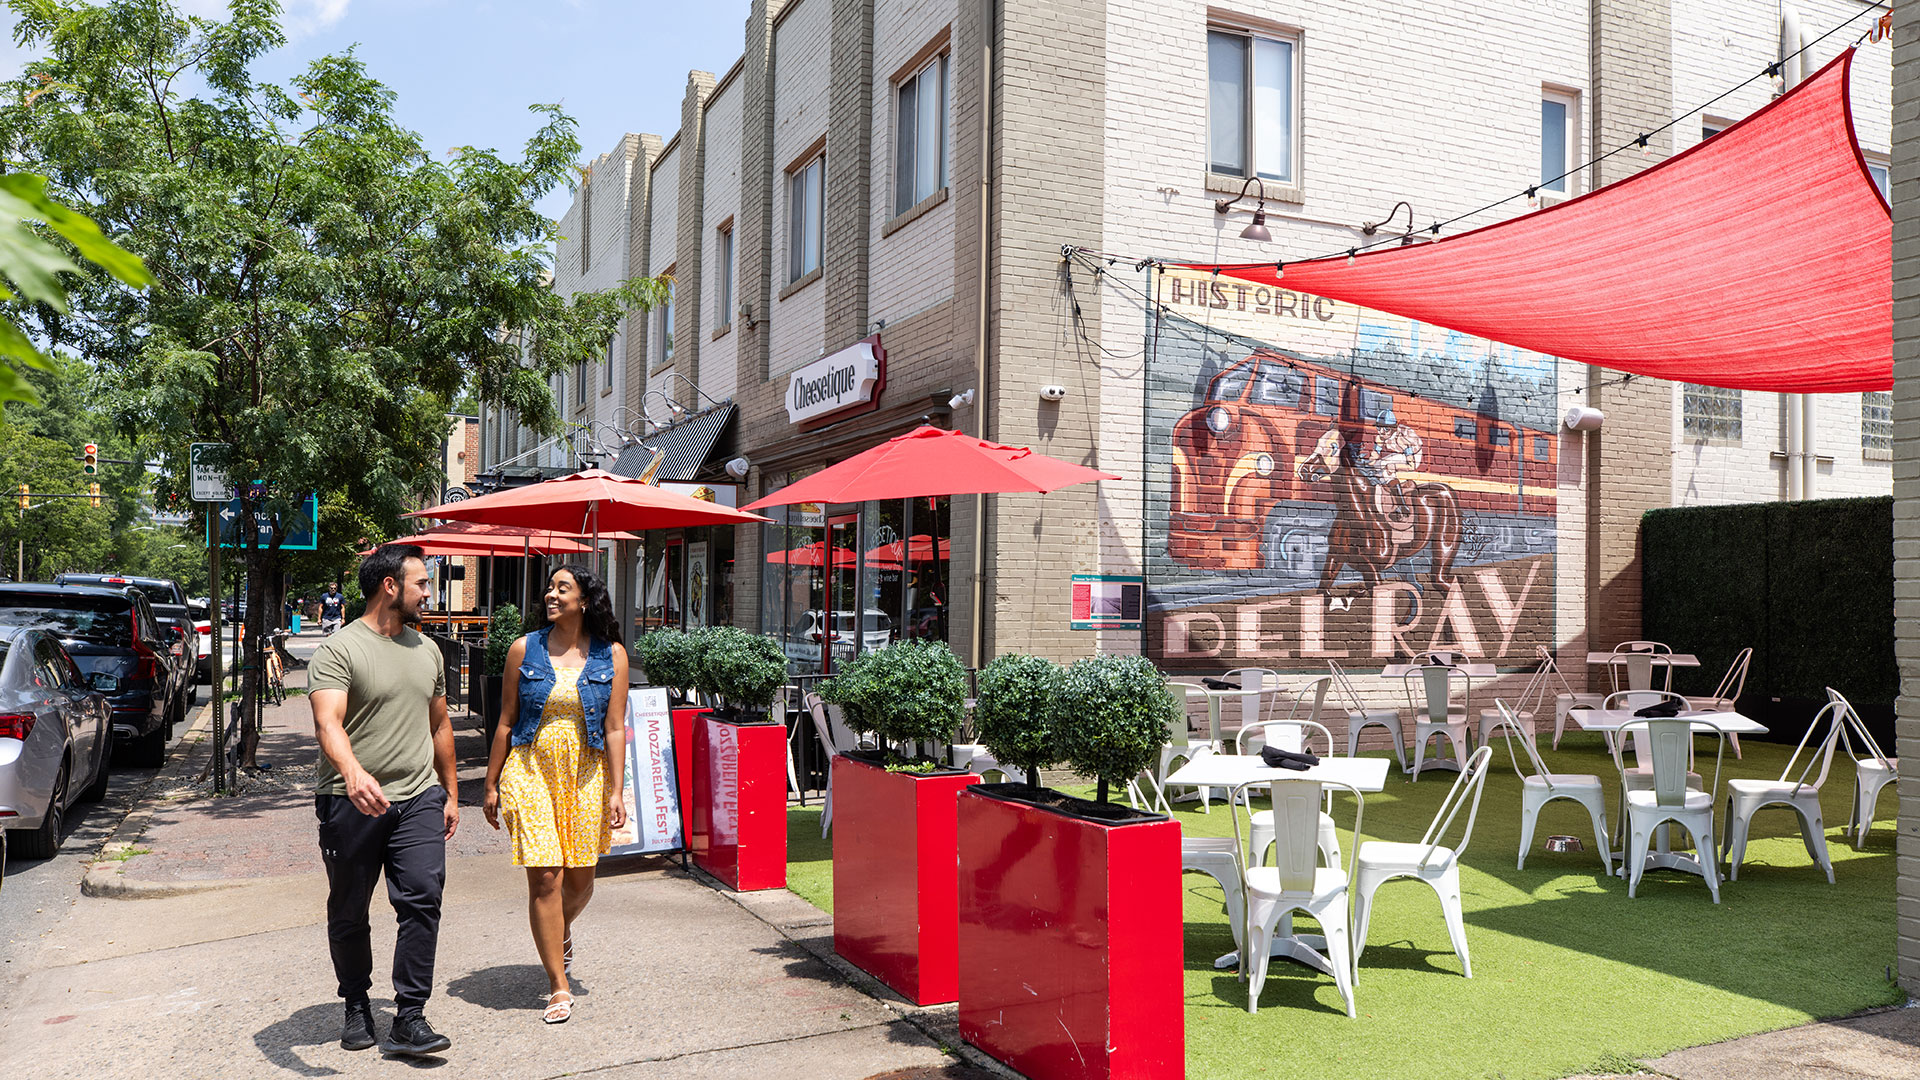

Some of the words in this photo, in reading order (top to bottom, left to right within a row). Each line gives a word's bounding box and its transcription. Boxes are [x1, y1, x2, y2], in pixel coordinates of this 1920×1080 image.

[1171, 278, 1335, 321] HISTORIC
[794, 364, 855, 410] Cheesetique
[193, 448, 201, 461] 2
[1163, 592, 1349, 659] DEL
[1372, 560, 1541, 659] RAY
[647, 720, 664, 804] MOZZARELLA
[656, 805, 668, 835] FEST
